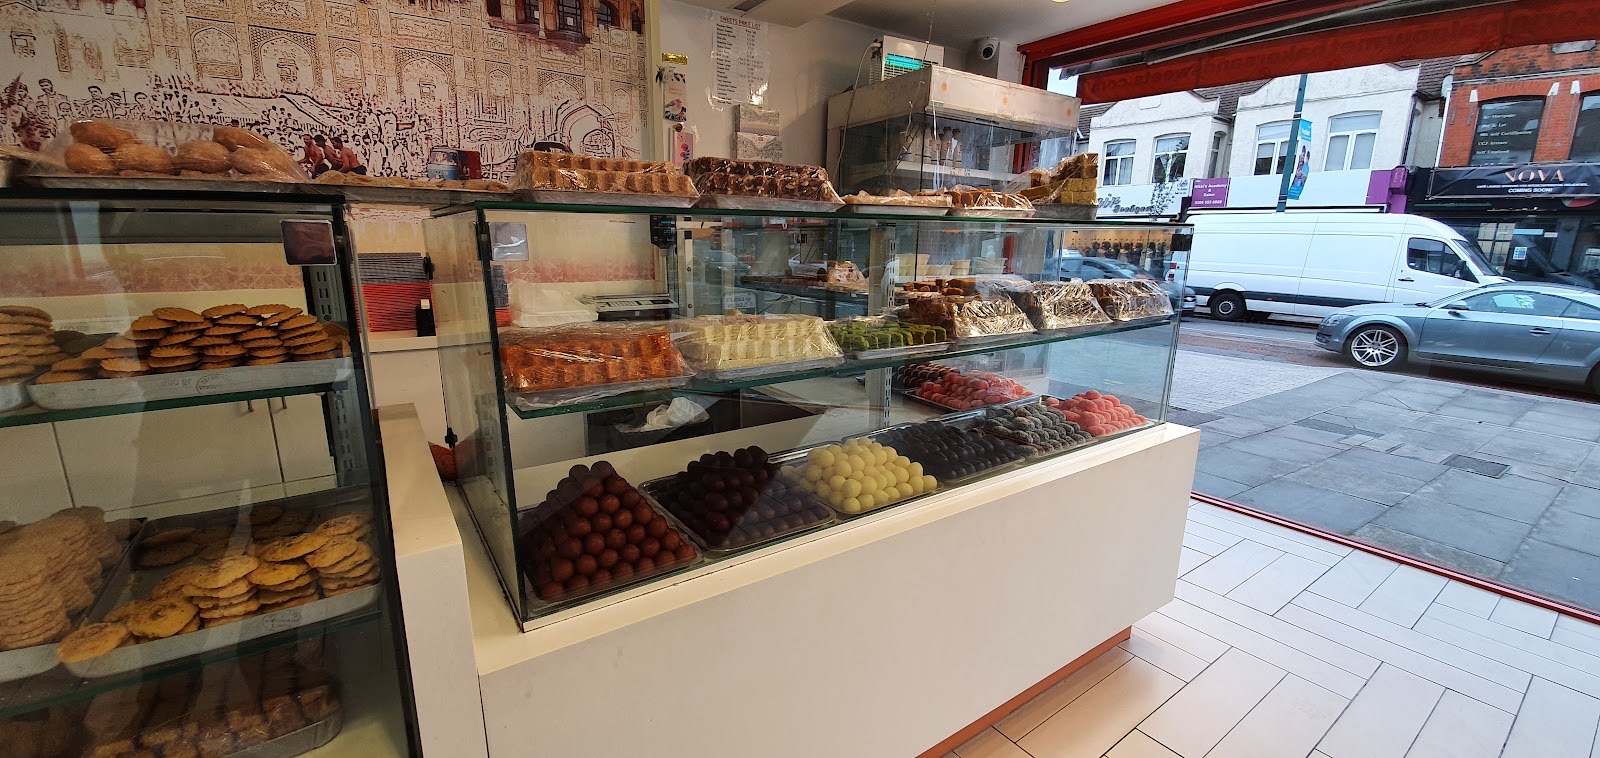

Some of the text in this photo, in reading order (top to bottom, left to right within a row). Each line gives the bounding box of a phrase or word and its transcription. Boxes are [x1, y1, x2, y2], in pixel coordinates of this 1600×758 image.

[719, 15, 738, 24] SWEETS
[738, 19, 751, 28] PRICE
[751, 22, 761, 30] LIST
[1504, 169, 1565, 183] NOVA
